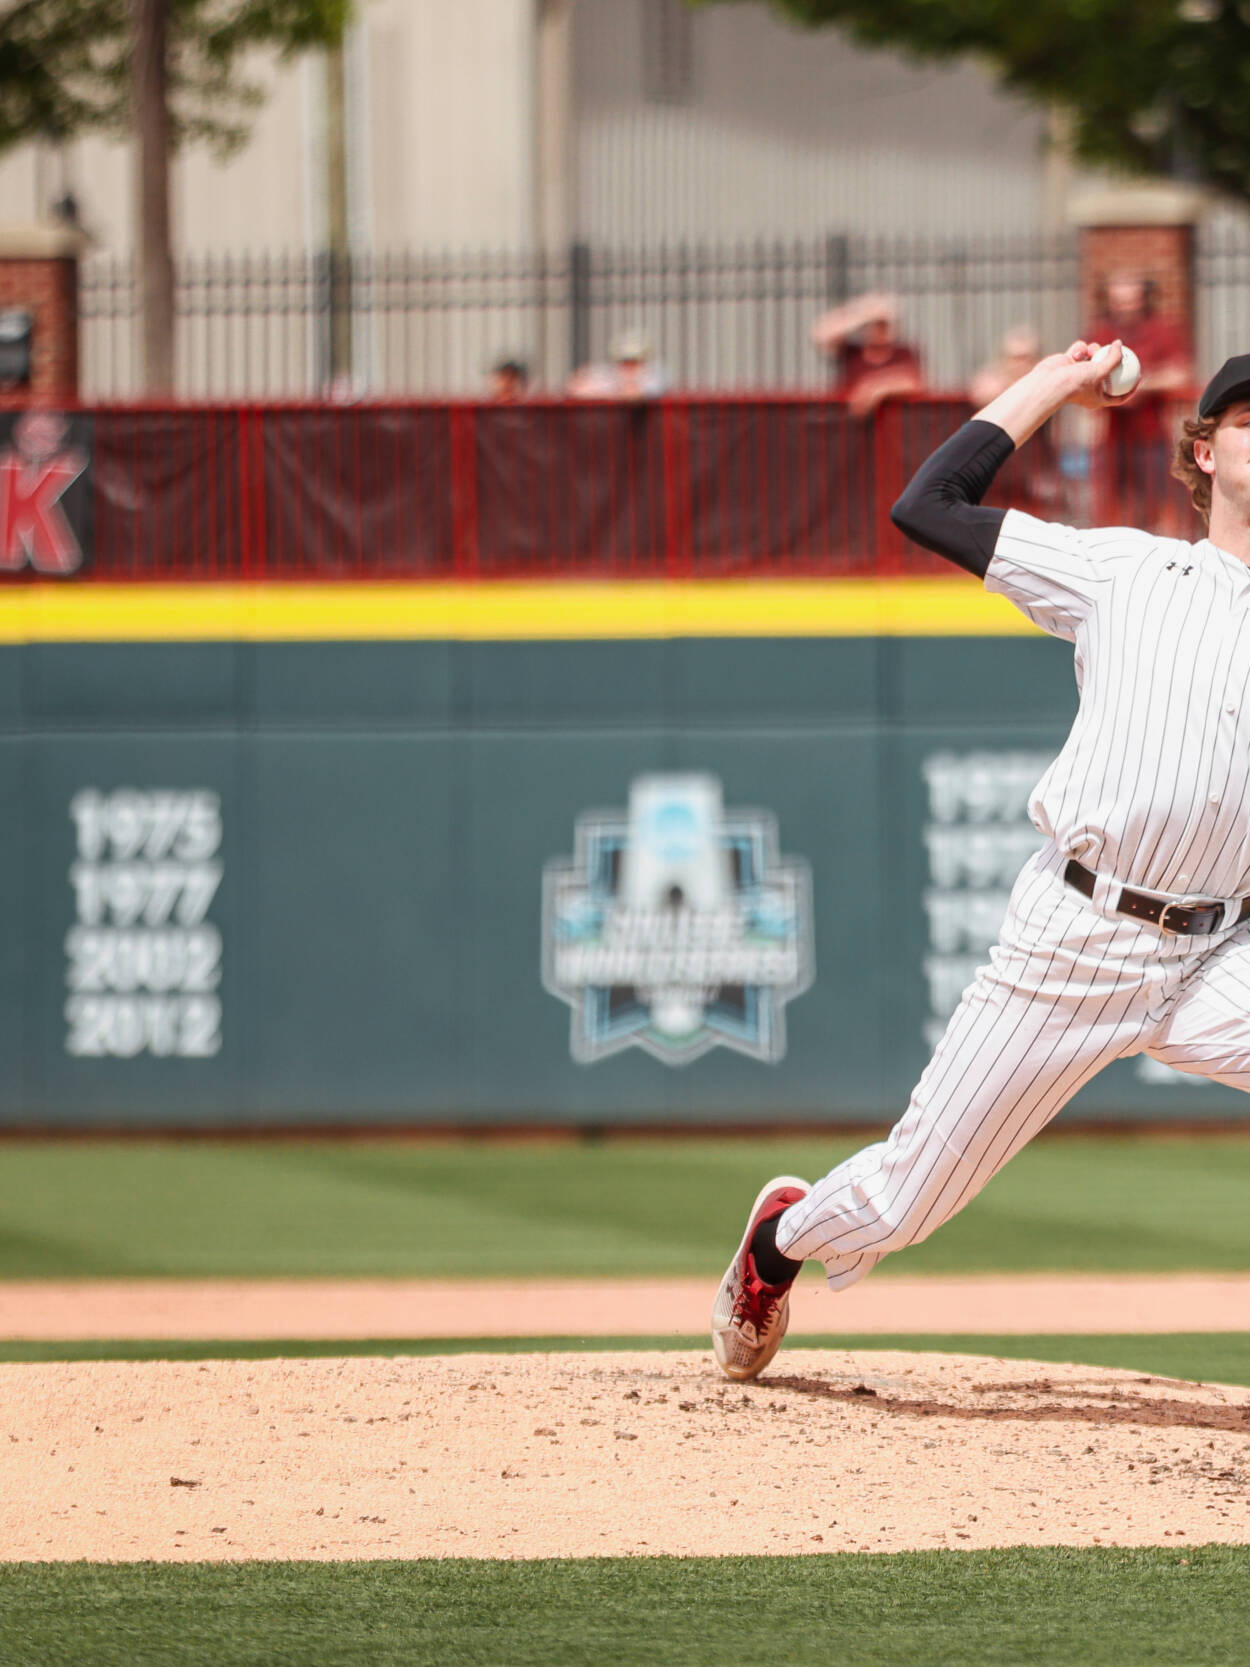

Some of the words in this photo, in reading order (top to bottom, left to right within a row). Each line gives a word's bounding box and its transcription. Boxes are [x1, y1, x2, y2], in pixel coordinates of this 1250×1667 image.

[68, 788, 223, 858] 1975
[68, 861, 225, 926] 1977
[64, 927, 223, 991] 2002
[64, 992, 223, 1057] 2012
